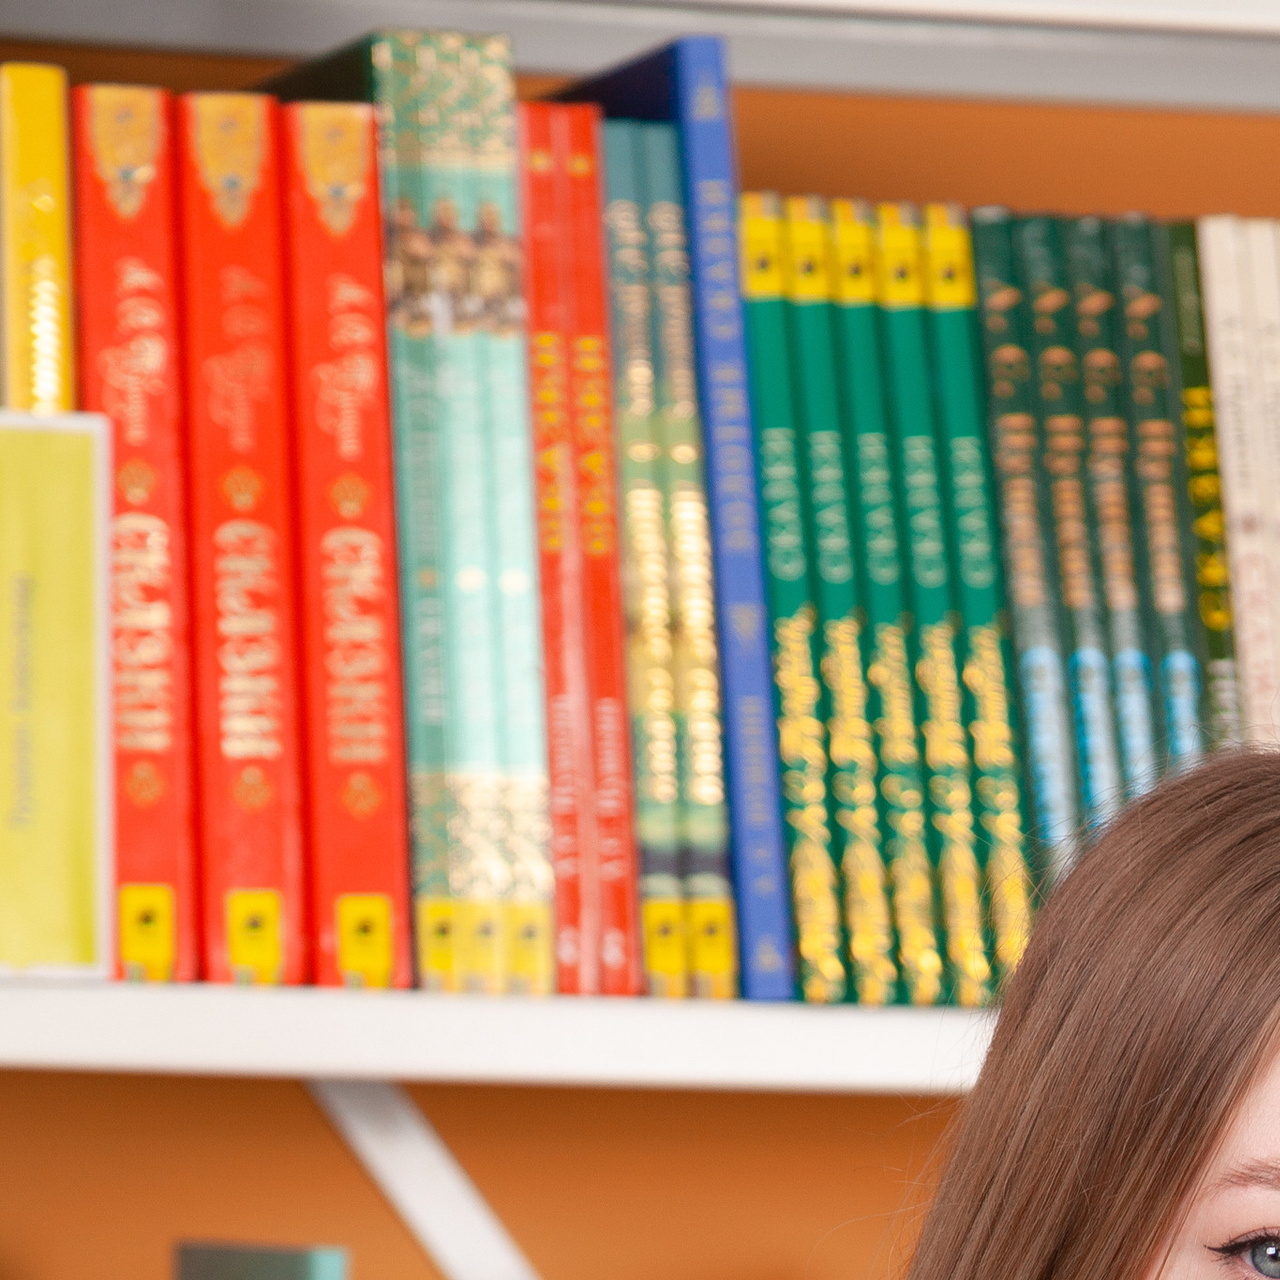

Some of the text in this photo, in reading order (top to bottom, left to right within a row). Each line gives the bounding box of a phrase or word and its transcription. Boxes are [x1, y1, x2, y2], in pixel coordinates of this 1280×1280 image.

[763, 428, 806, 578] СКАЗКИ
[810, 431, 853, 582] СКАЗКИ
[858, 433, 899, 586] СКАЗКИ
[905, 435, 947, 588] СКАЗКИ
[952, 437, 994, 588] СКАЗКИ
[1181, 386, 1232, 631] СКАЗКИ
[111, 512, 171, 752] СКАЗКИ
[214, 521, 282, 761] СКАЗКИ
[321, 527, 390, 765] СКАЗКИ
